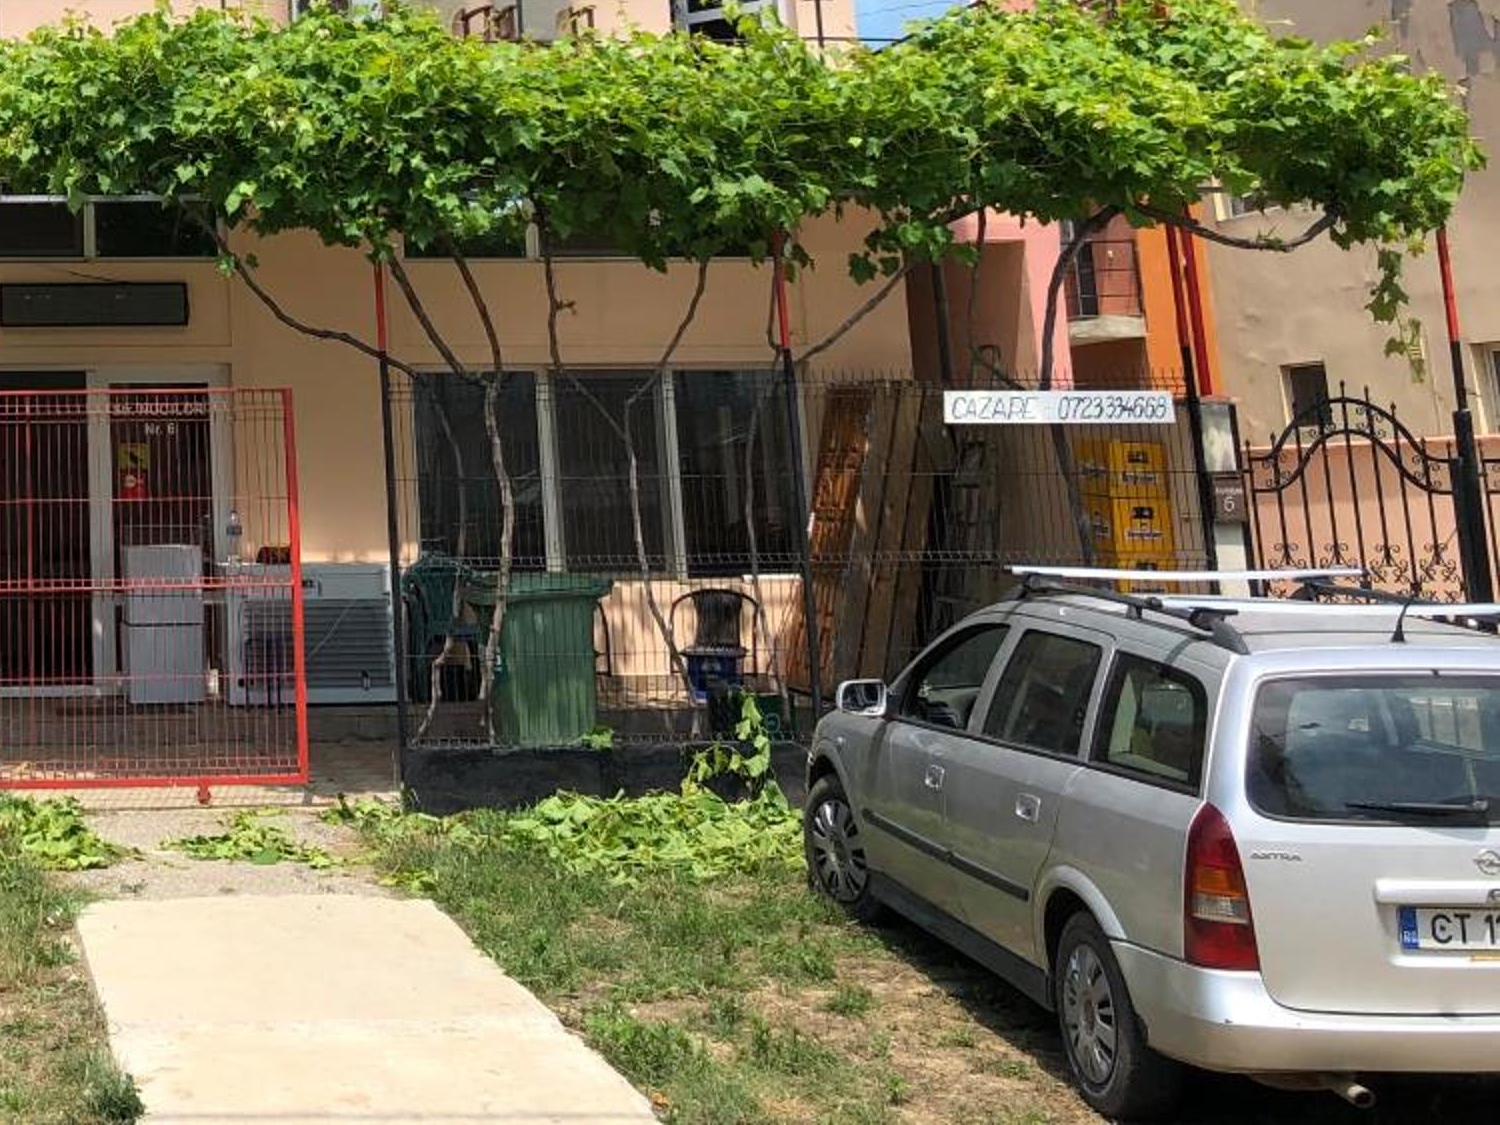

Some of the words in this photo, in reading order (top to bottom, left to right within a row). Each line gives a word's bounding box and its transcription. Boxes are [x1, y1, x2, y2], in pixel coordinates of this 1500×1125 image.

[951, 395, 1039, 420] CAZARE
[1430, 912, 1472, 945] CT
[1483, 912, 1500, 946] 1
